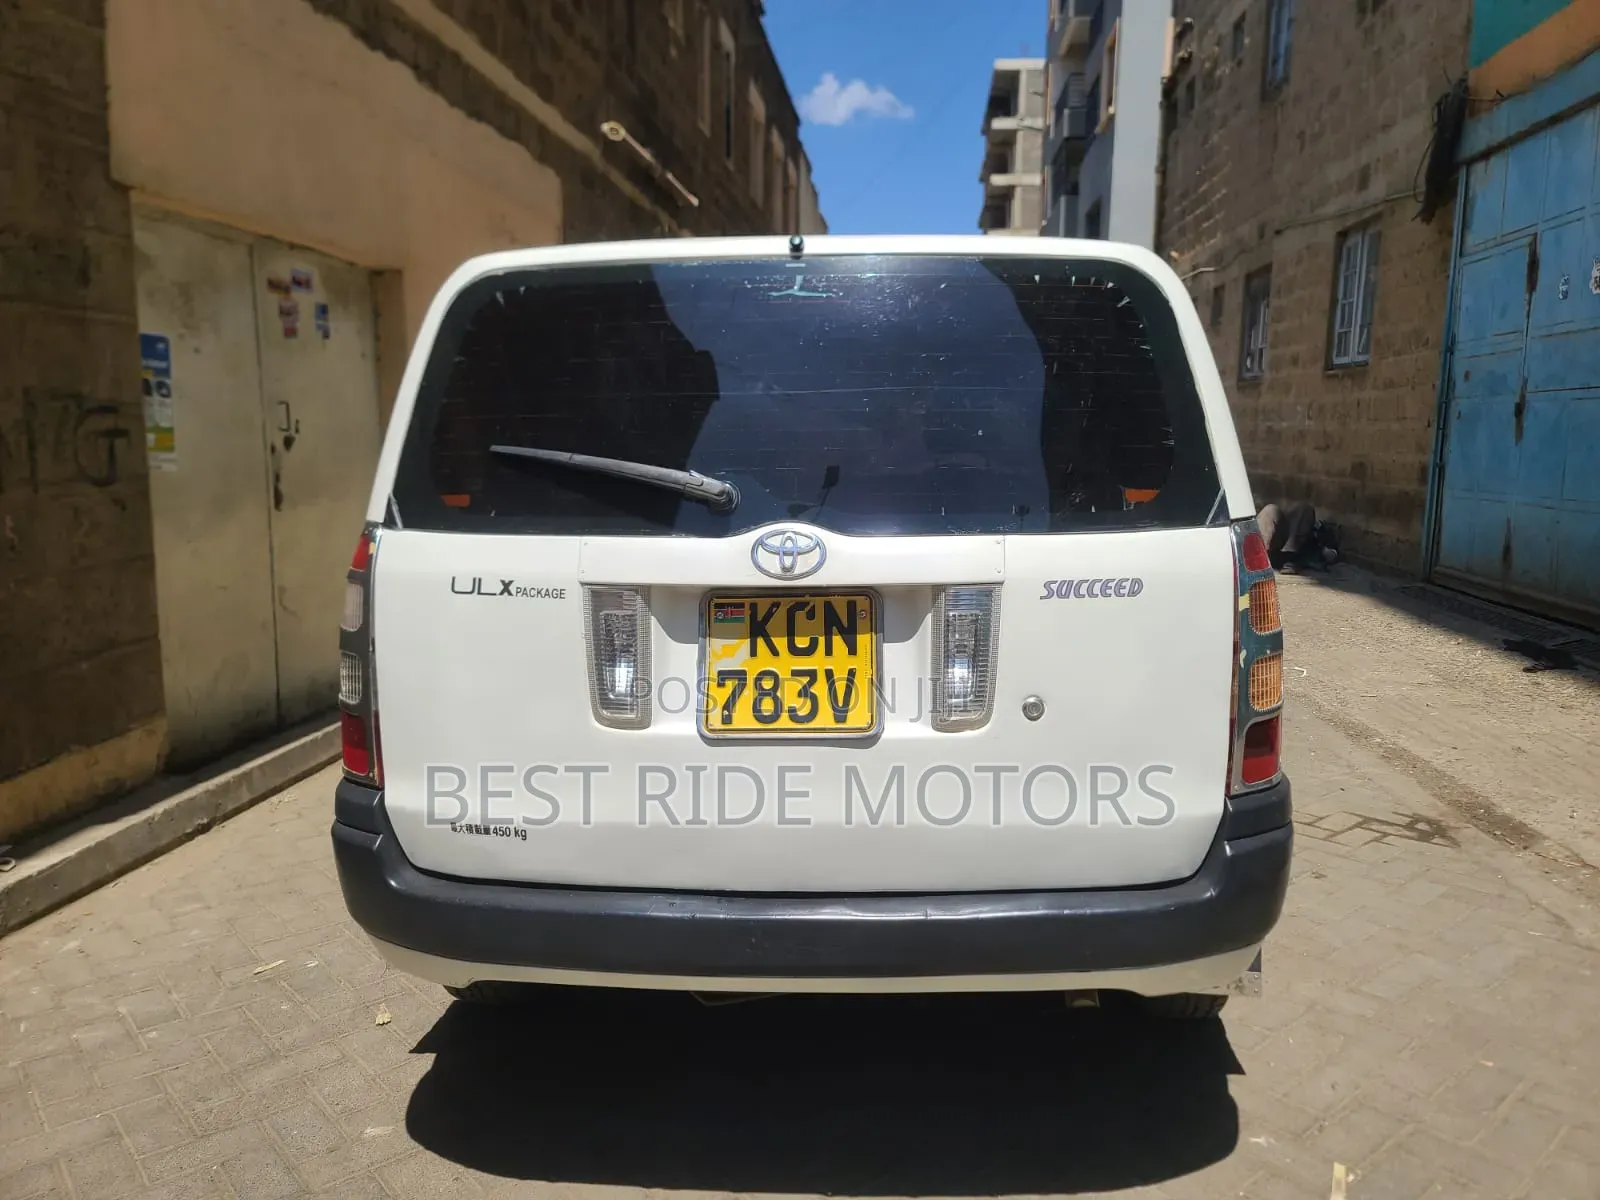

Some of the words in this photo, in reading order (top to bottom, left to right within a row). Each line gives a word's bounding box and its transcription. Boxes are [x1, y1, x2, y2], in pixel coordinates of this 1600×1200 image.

[451, 576, 515, 597] ULX
[515, 586, 566, 599] PACKAGE
[1039, 577, 1144, 600] SUCCEED
[749, 600, 858, 658] KCN
[717, 667, 857, 725] 783V
[513, 826, 528, 841] kg
